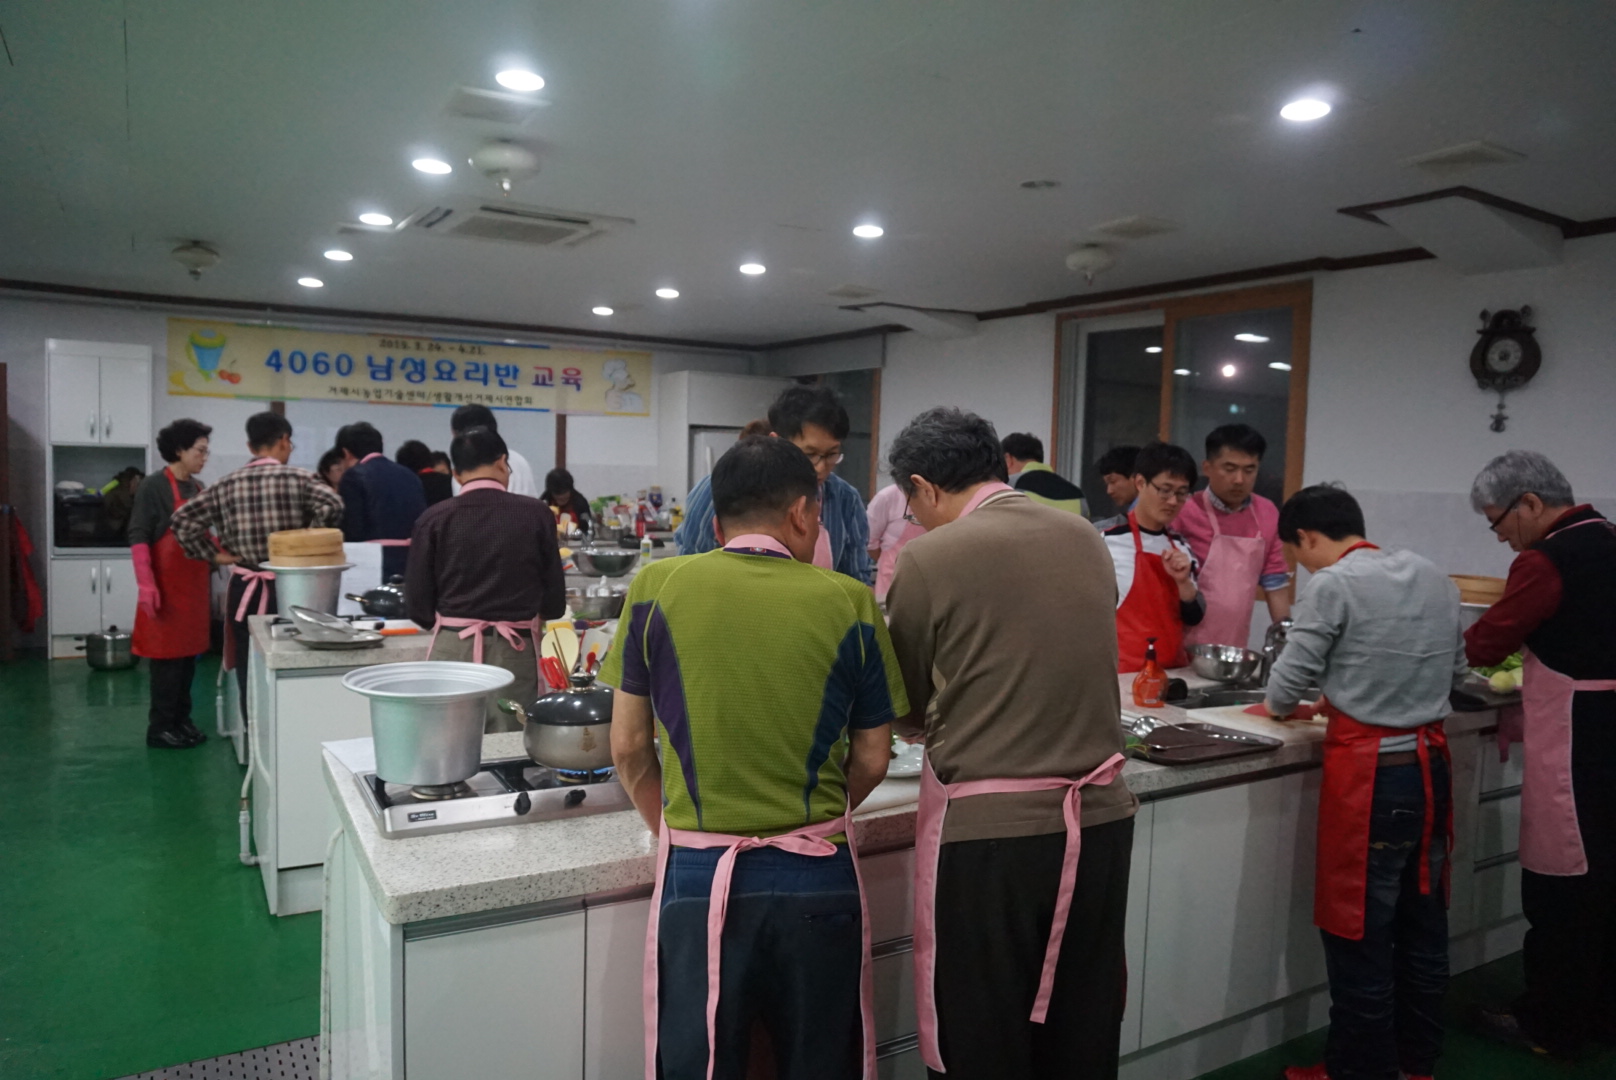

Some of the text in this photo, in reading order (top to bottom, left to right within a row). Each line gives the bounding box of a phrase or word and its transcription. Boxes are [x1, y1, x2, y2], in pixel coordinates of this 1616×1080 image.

[265, 349, 583, 391] 4060 남성요리반 교육
